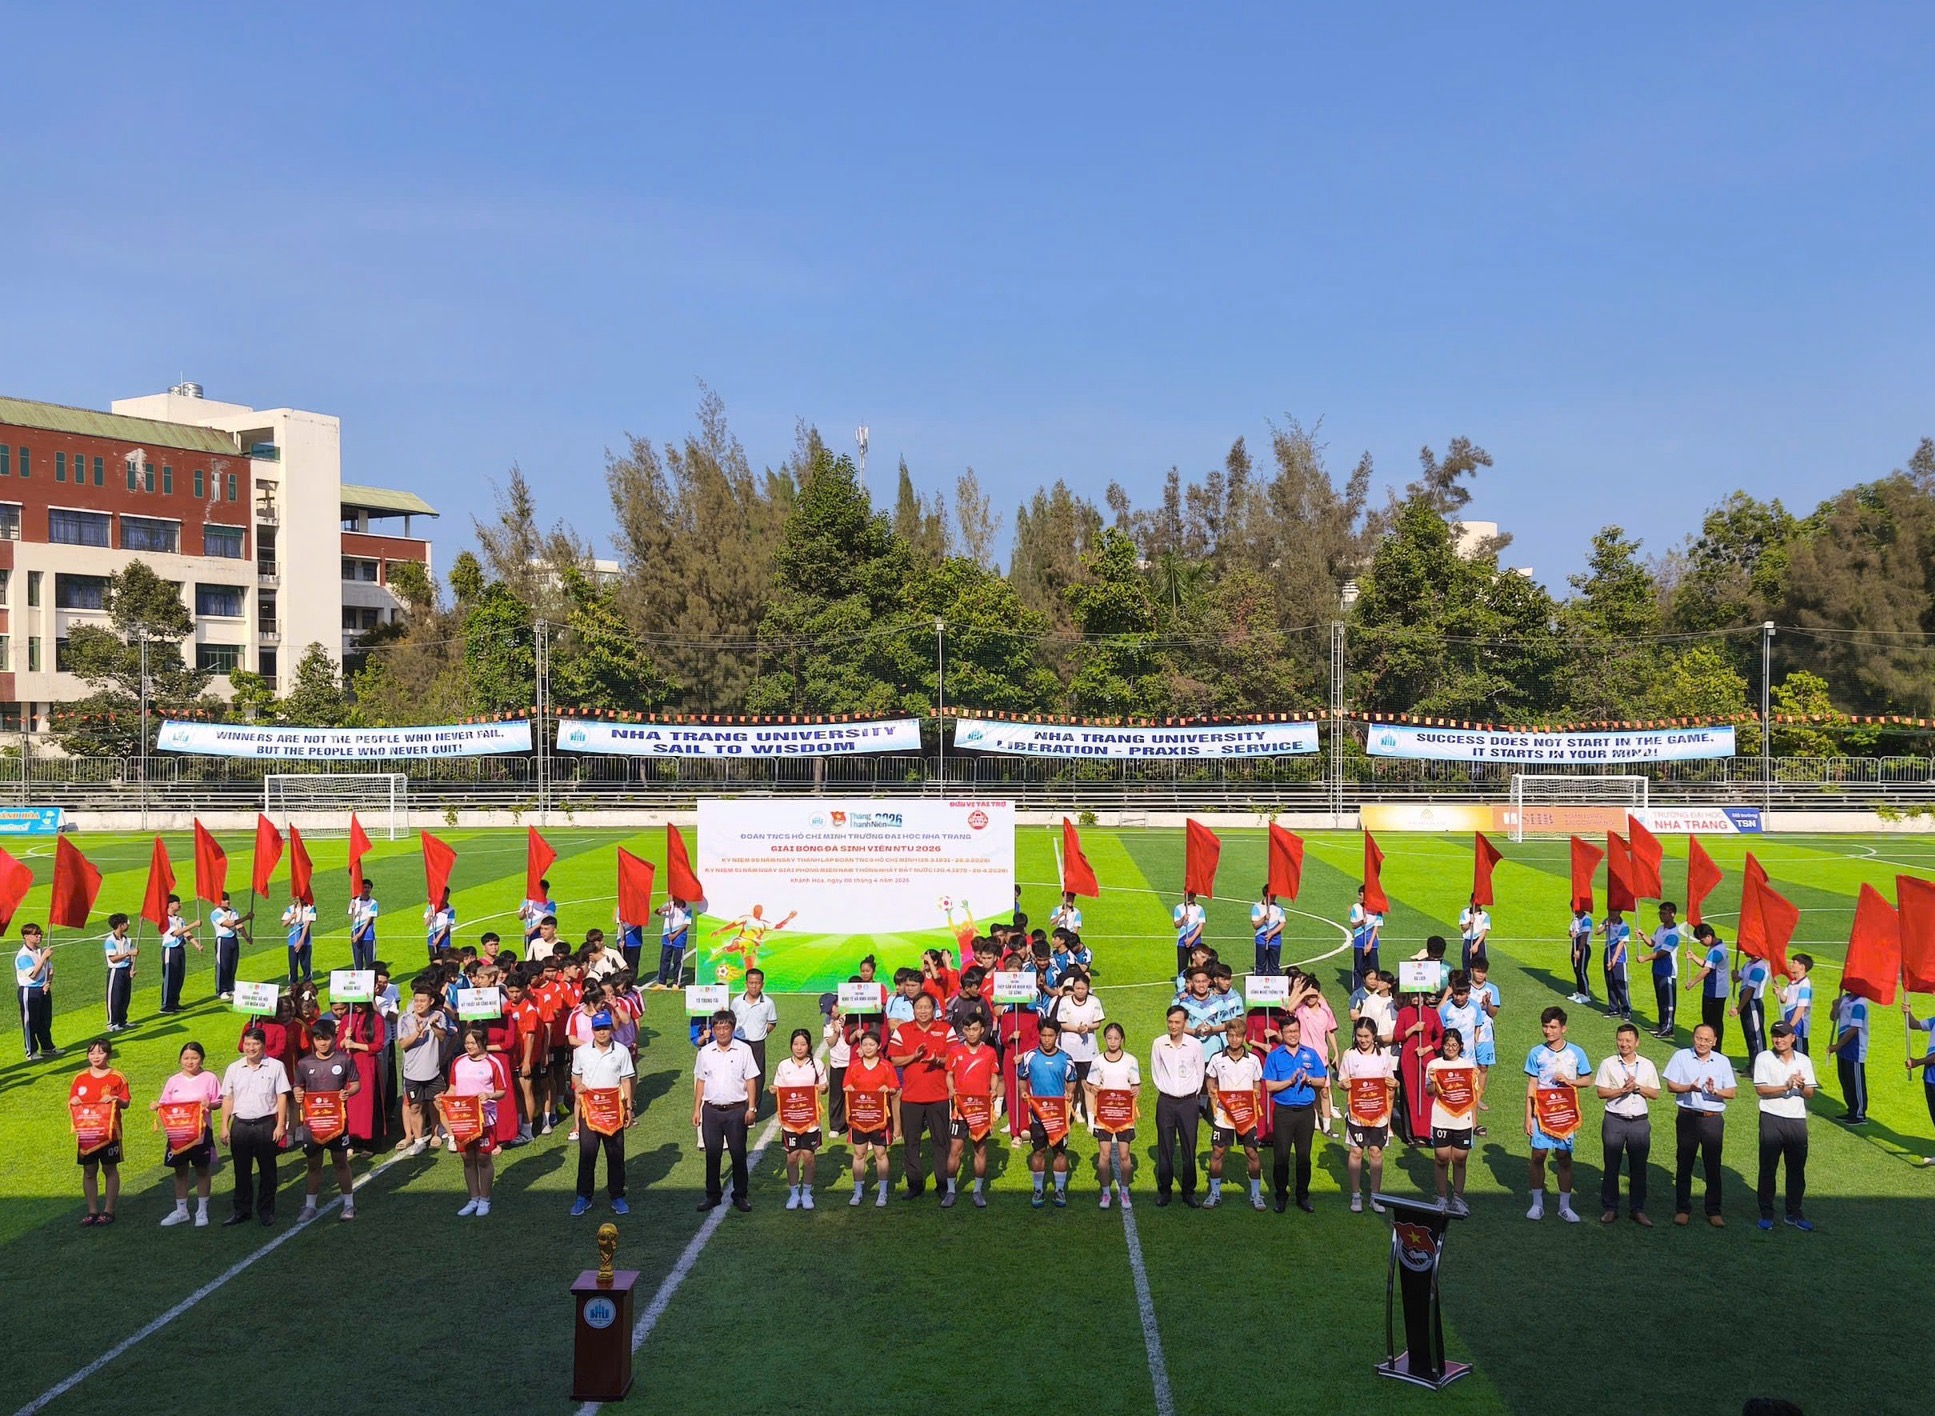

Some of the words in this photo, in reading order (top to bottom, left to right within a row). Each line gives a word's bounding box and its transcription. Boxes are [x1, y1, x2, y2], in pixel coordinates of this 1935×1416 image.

[216, 731, 272, 743] WINNERS
[277, 735, 296, 743] ARE
[304, 735, 327, 744] NOT
[331, 735, 351, 744] THE
[356, 734, 400, 744] PEOPLE
[405, 733, 431, 743] WHO
[435, 731, 473, 741] NEVER
[477, 729, 504, 739] FAIL.
[611, 729, 662, 740] NHA
[669, 732, 748, 742] TRANG
[756, 726, 896, 741] UNIVERSITY
[1034, 731, 1074, 742] NHA
[1081, 733, 1145, 744] TRANG
[1151, 731, 1265, 744] UNIVERSITY
[1416, 733, 1485, 745] SUCCESS
[1490, 736, 1529, 746] DOES
[1534, 738, 1562, 747] NOT
[1567, 738, 1610, 747] START
[1615, 737, 1631, 746] IN
[1636, 736, 1662, 745] THE
[1667, 733, 1714, 745] GAME.
[257, 746, 280, 755] BUT
[283, 746, 305, 755] THE
[308, 747, 353, 756] PEOPLE
[358, 747, 386, 756] WHO
[389, 746, 428, 756] NEVER
[432, 744, 462, 754] QUIT!
[653, 743, 705, 754] SAIL
[713, 745, 742, 754] TO
[751, 741, 855, 754] WISDOM
[997, 740, 1108, 755] LIBERATION
[1129, 746, 1200, 756] PRAXIS
[1221, 741, 1303, 755] SERVICE
[1472, 747, 1484, 757] IT
[1490, 748, 1544, 758] STARTS
[1548, 750, 1564, 759] IN
[1569, 750, 1607, 759] YOUR
[1654, 820, 1681, 829] NHA
[1684, 820, 1728, 829] TRANG
[1736, 819, 1757, 828] TSN
[767, 832, 790, 840] TNCS
[823, 832, 846, 840] MINH
[922, 832, 940, 840] NHA
[942, 832, 971, 840] TRANG
[840, 844, 866, 852] SINH
[893, 844, 915, 852] NTU
[916, 844, 941, 852] 2026
[951, 1123, 959, 1135] 11
[1354, 1133, 1363, 1143] 10
[108, 1145, 119, 1156] 09
